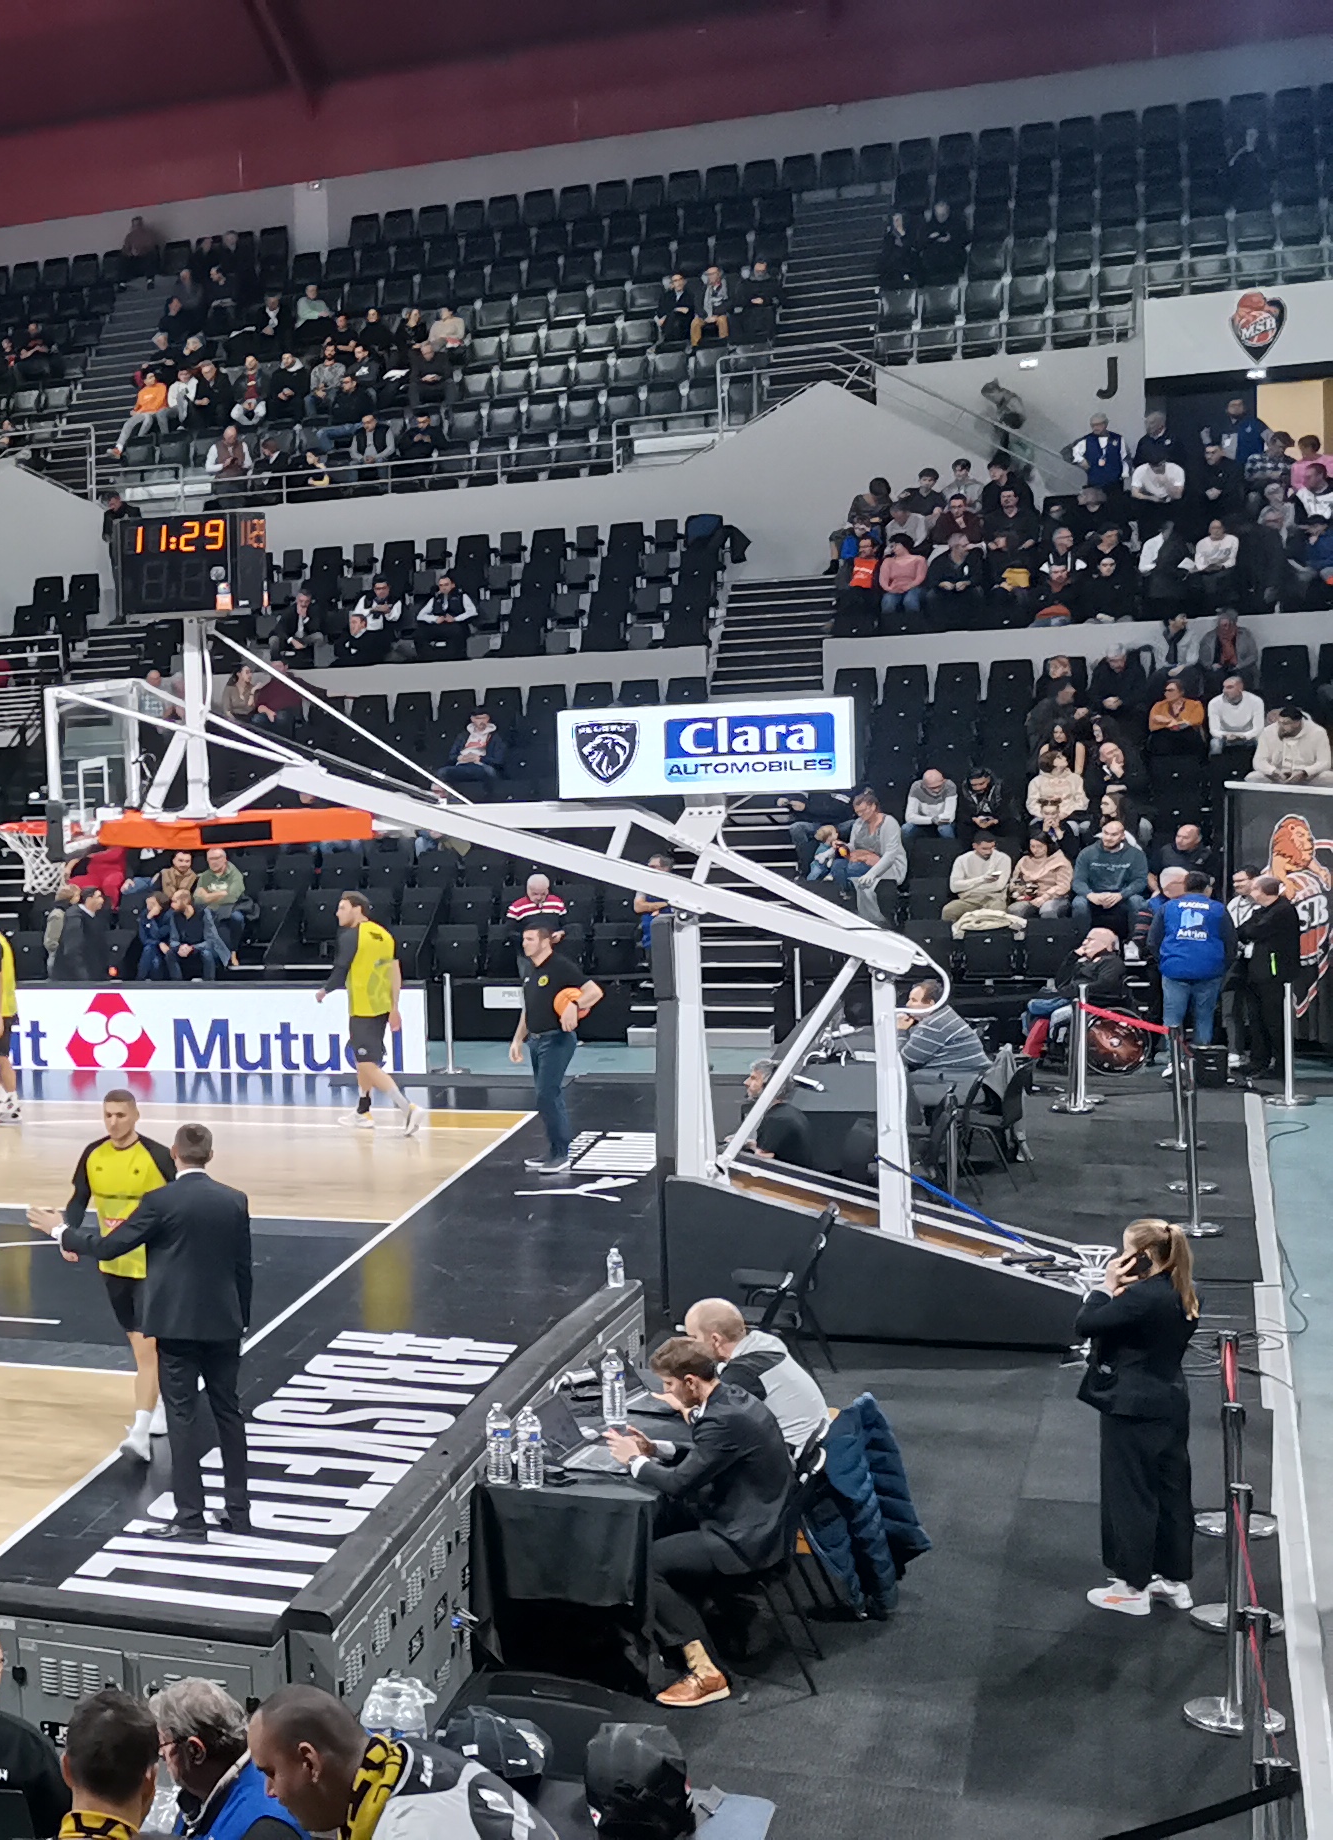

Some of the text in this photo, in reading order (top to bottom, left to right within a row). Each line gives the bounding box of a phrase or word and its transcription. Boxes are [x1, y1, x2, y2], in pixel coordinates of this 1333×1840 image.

[1240, 315, 1277, 339] MSB
[1095, 356, 1119, 400] J
[134, 518, 227, 555] 11:29
[679, 716, 818, 756] Clara
[667, 758, 834, 777] AUTOMOBILES
